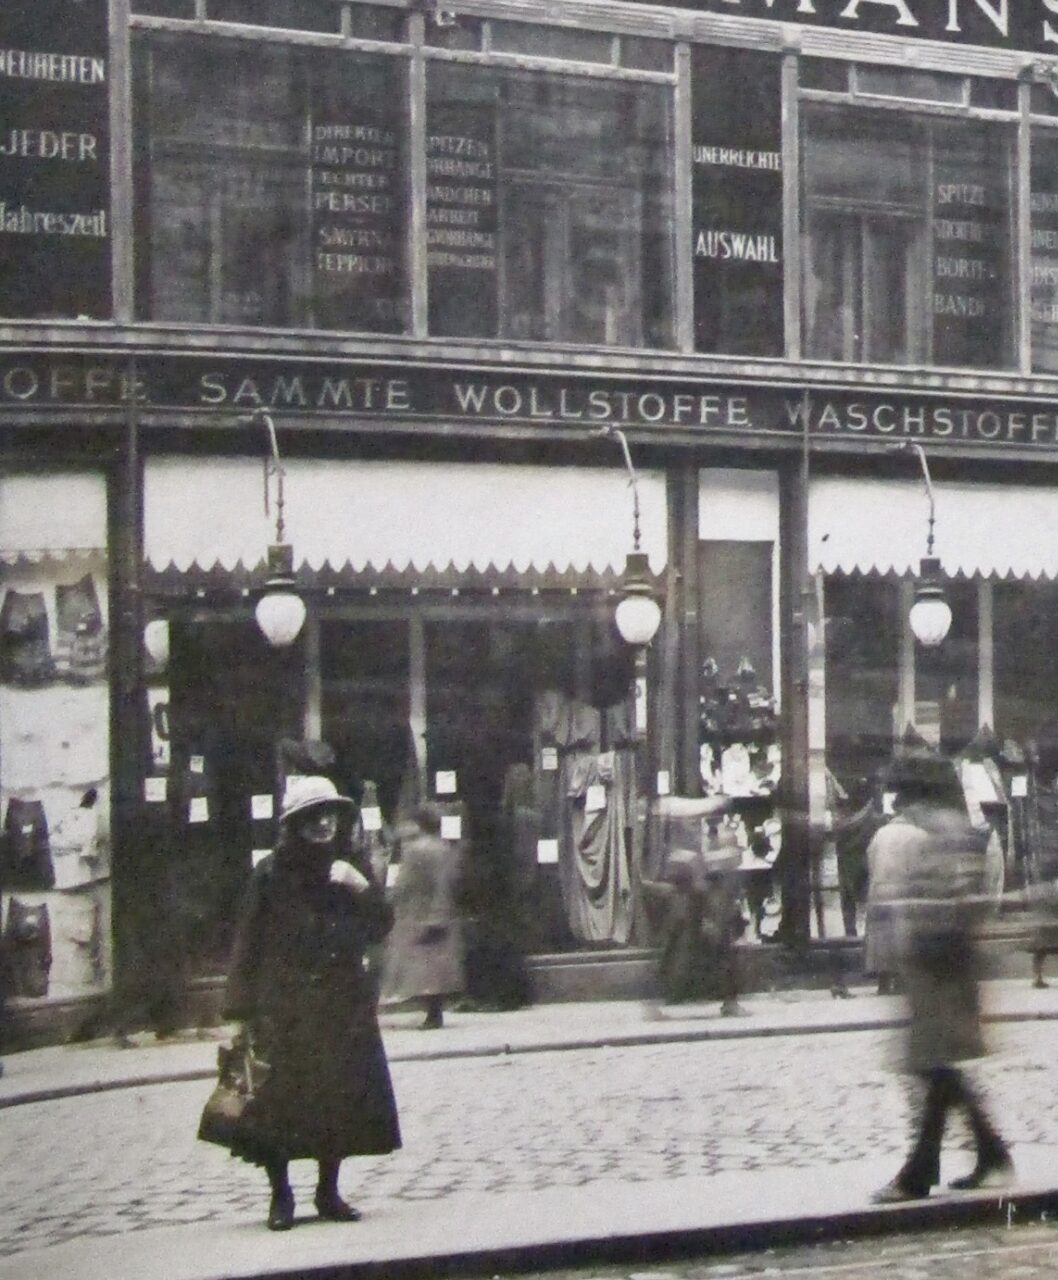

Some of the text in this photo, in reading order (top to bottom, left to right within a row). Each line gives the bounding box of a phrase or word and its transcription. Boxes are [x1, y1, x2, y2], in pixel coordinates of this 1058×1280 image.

[0, 129, 97, 161] JEDER
[692, 144, 782, 171] UNERREICHTE
[695, 230, 779, 263] AUSWAHL
[201, 373, 411, 411] SAMMTE
